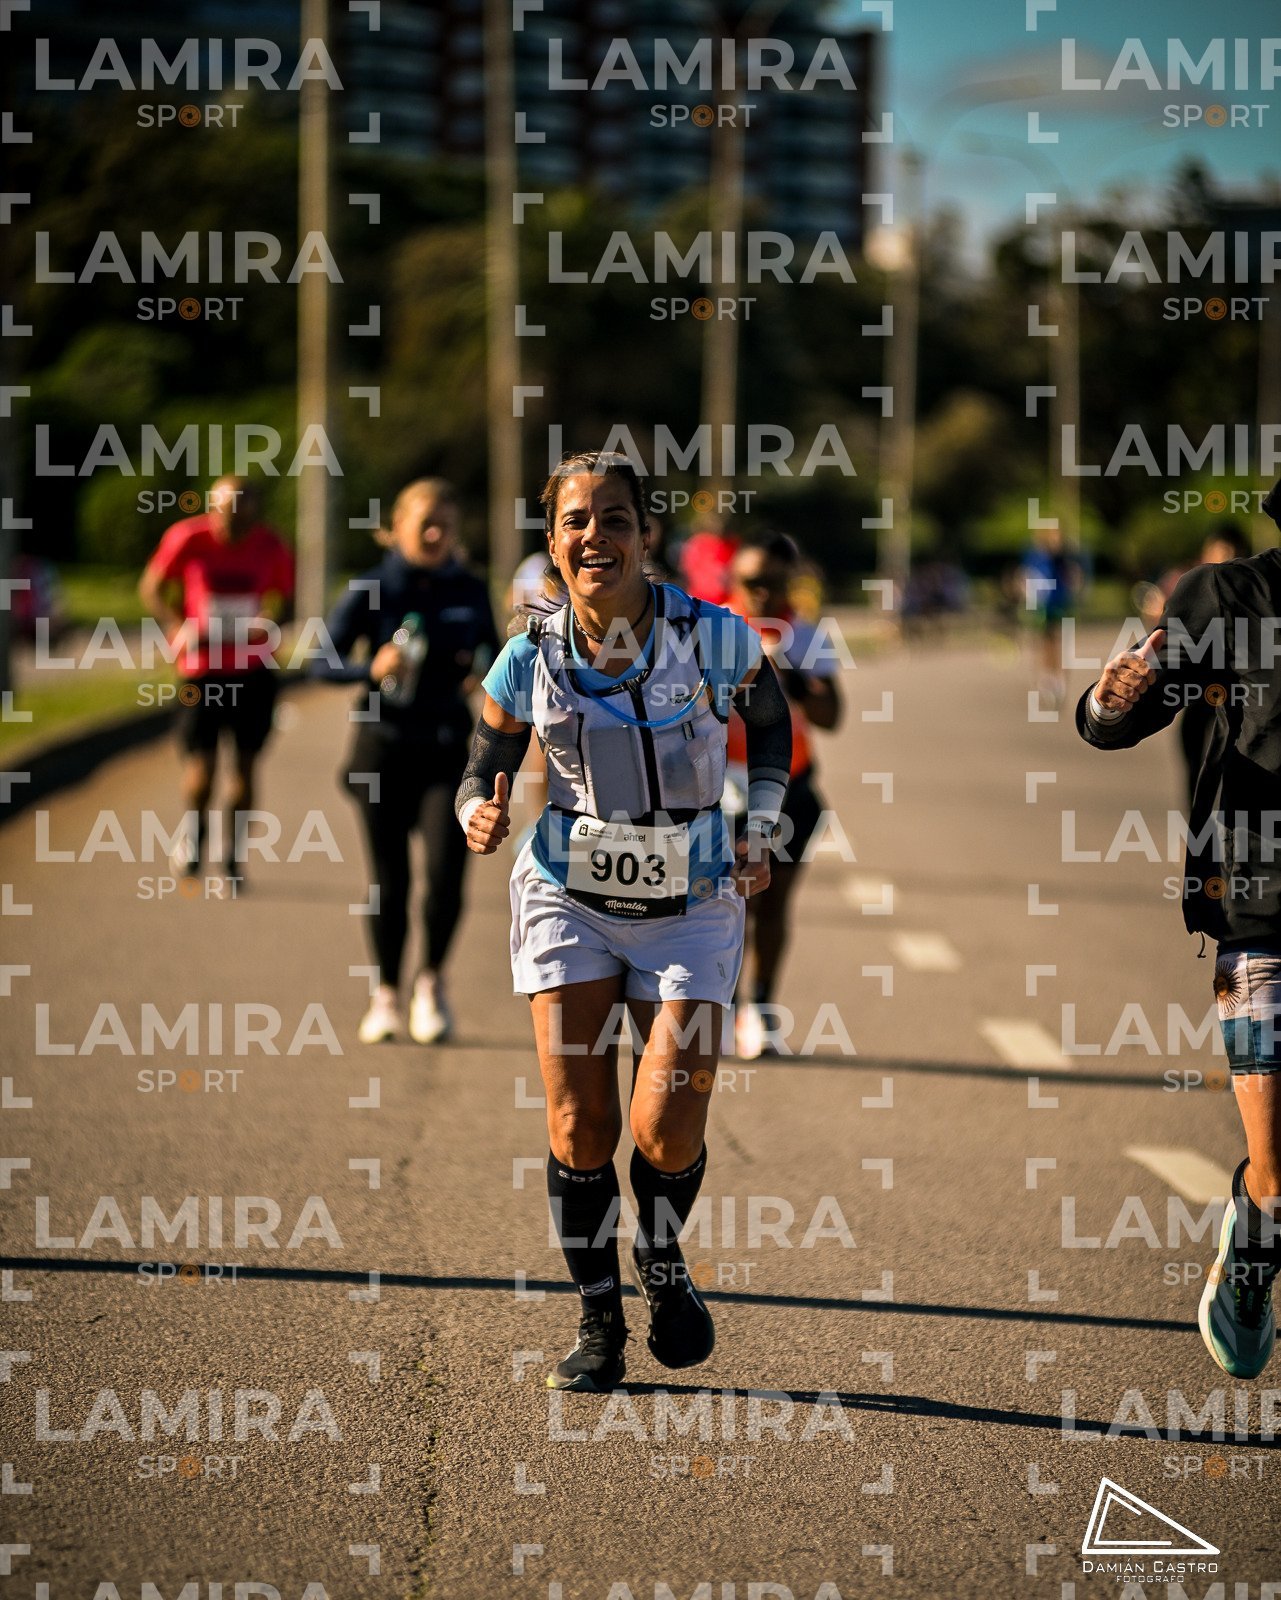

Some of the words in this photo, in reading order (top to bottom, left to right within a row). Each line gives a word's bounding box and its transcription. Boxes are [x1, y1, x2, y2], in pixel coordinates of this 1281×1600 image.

[623, 832, 646, 843] antel
[590, 849, 666, 887] 903
[604, 899, 648, 912] Maratón
